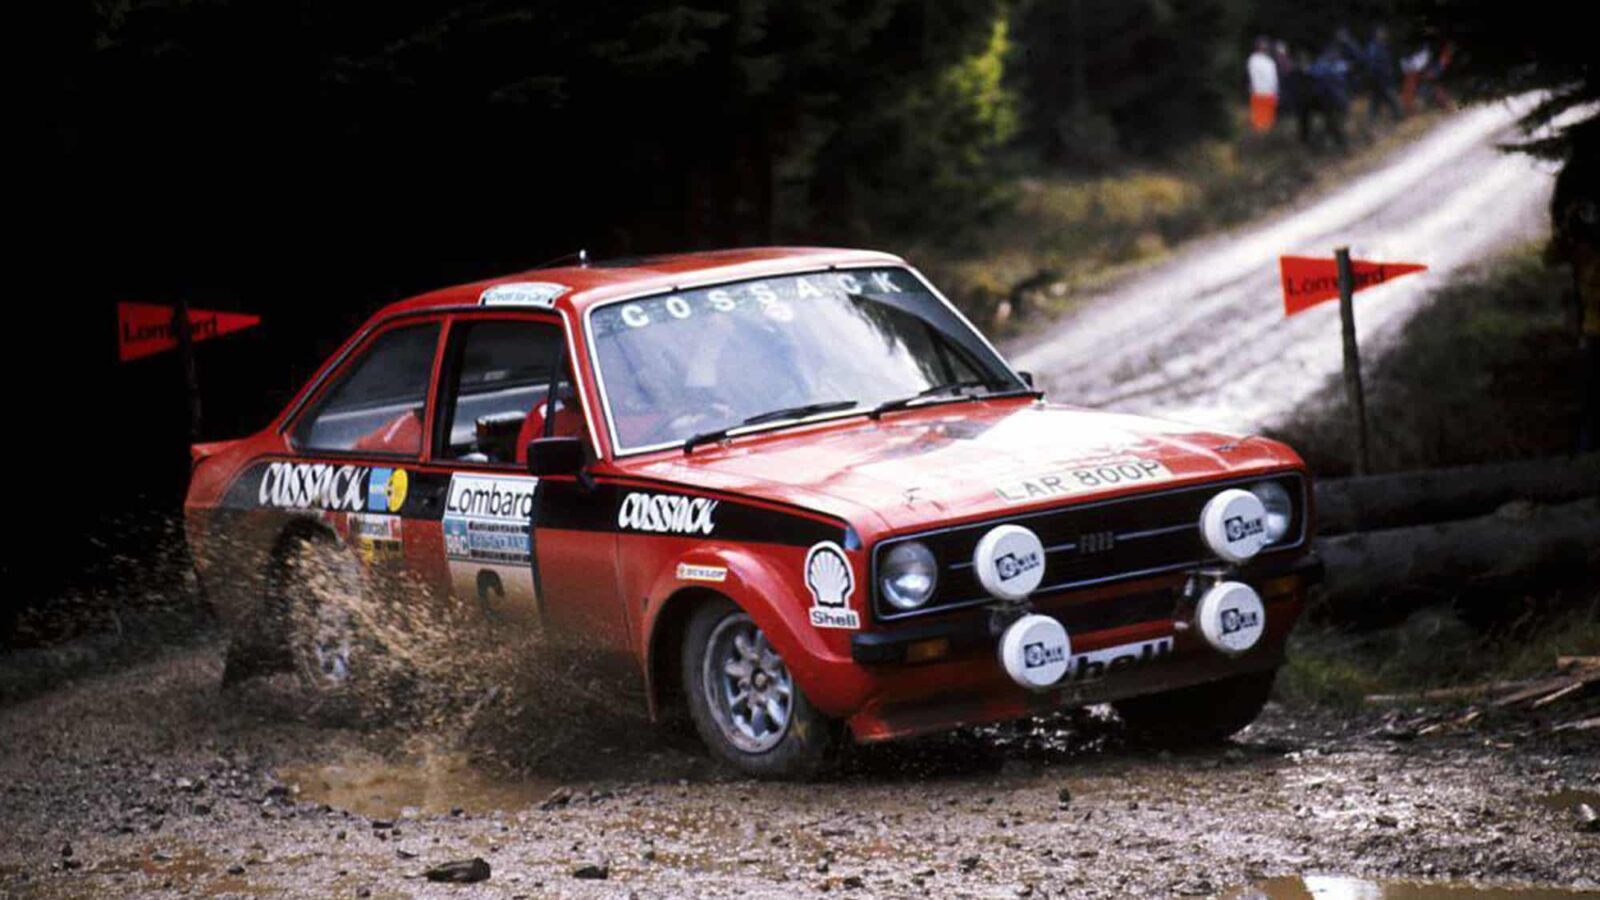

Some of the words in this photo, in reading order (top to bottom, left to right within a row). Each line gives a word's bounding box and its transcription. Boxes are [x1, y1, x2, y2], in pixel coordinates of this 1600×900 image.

[621, 271, 902, 327] COSSACK
[1287, 265, 1384, 296] Lomard
[125, 314, 217, 342] Lomard
[258, 462, 369, 511] COSSACK
[994, 475, 1071, 501] LAR
[1072, 460, 1159, 487] 800P
[618, 493, 719, 536] COSSACK
[812, 610, 857, 626] Shell
[1069, 640, 1170, 681] hell
